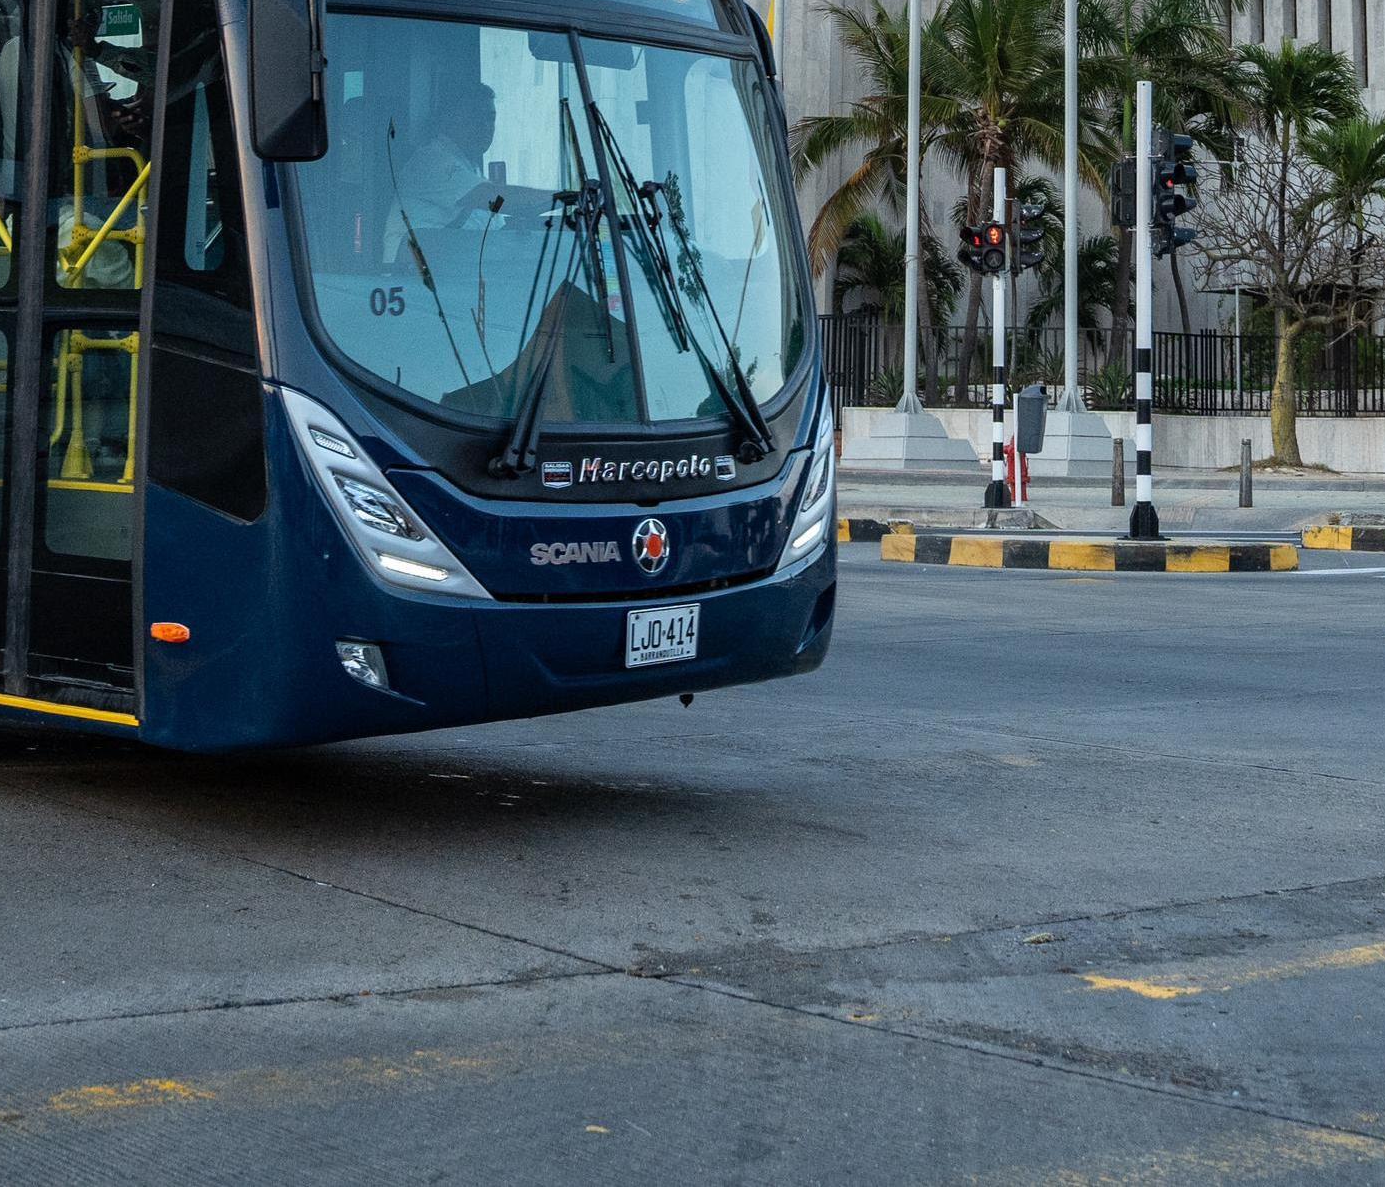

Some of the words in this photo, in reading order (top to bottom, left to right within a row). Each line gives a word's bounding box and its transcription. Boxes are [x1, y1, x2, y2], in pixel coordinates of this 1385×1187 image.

[108, 9, 133, 24] Salida
[370, 286, 406, 317] 05
[579, 454, 711, 483] Marcopolo
[530, 541, 622, 566] SCANIA
